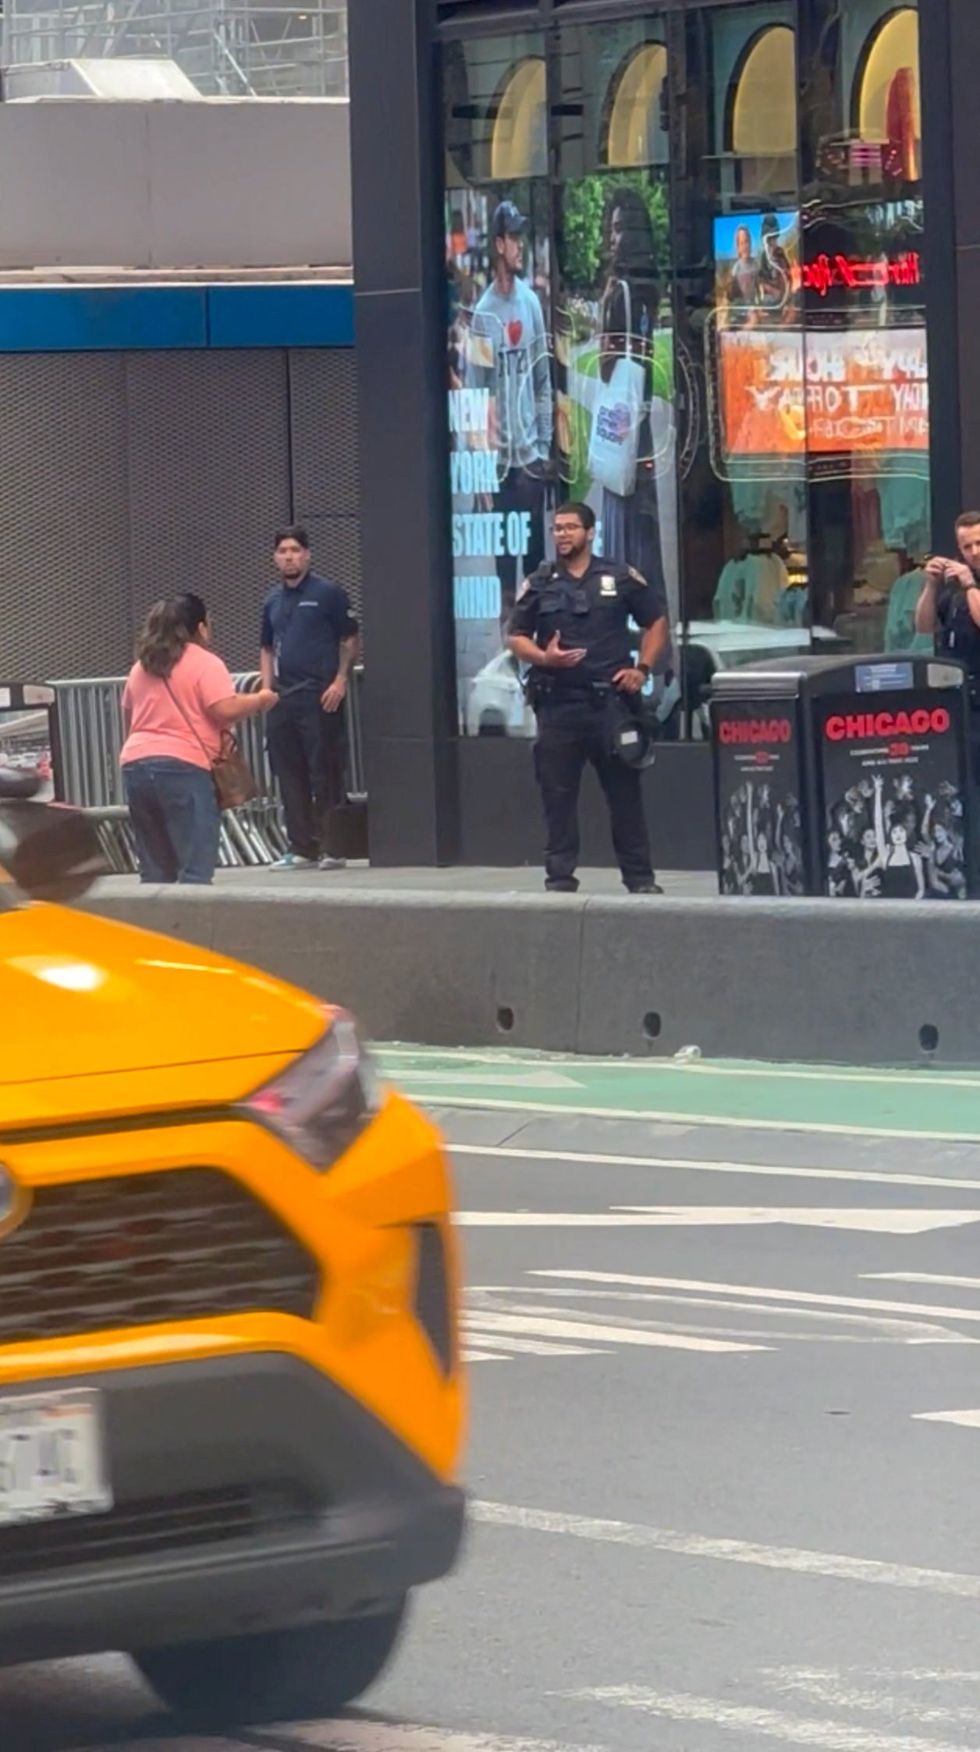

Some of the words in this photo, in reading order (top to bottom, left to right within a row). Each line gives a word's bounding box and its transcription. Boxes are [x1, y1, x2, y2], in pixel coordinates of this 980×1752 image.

[448, 387, 490, 431] NEW
[450, 450, 500, 494] YORK
[452, 512, 504, 556] STATE
[507, 511, 532, 556] OF
[454, 575, 501, 619] MIND
[719, 719, 792, 743] CHICAGO
[825, 708, 950, 741] CHICAGO
